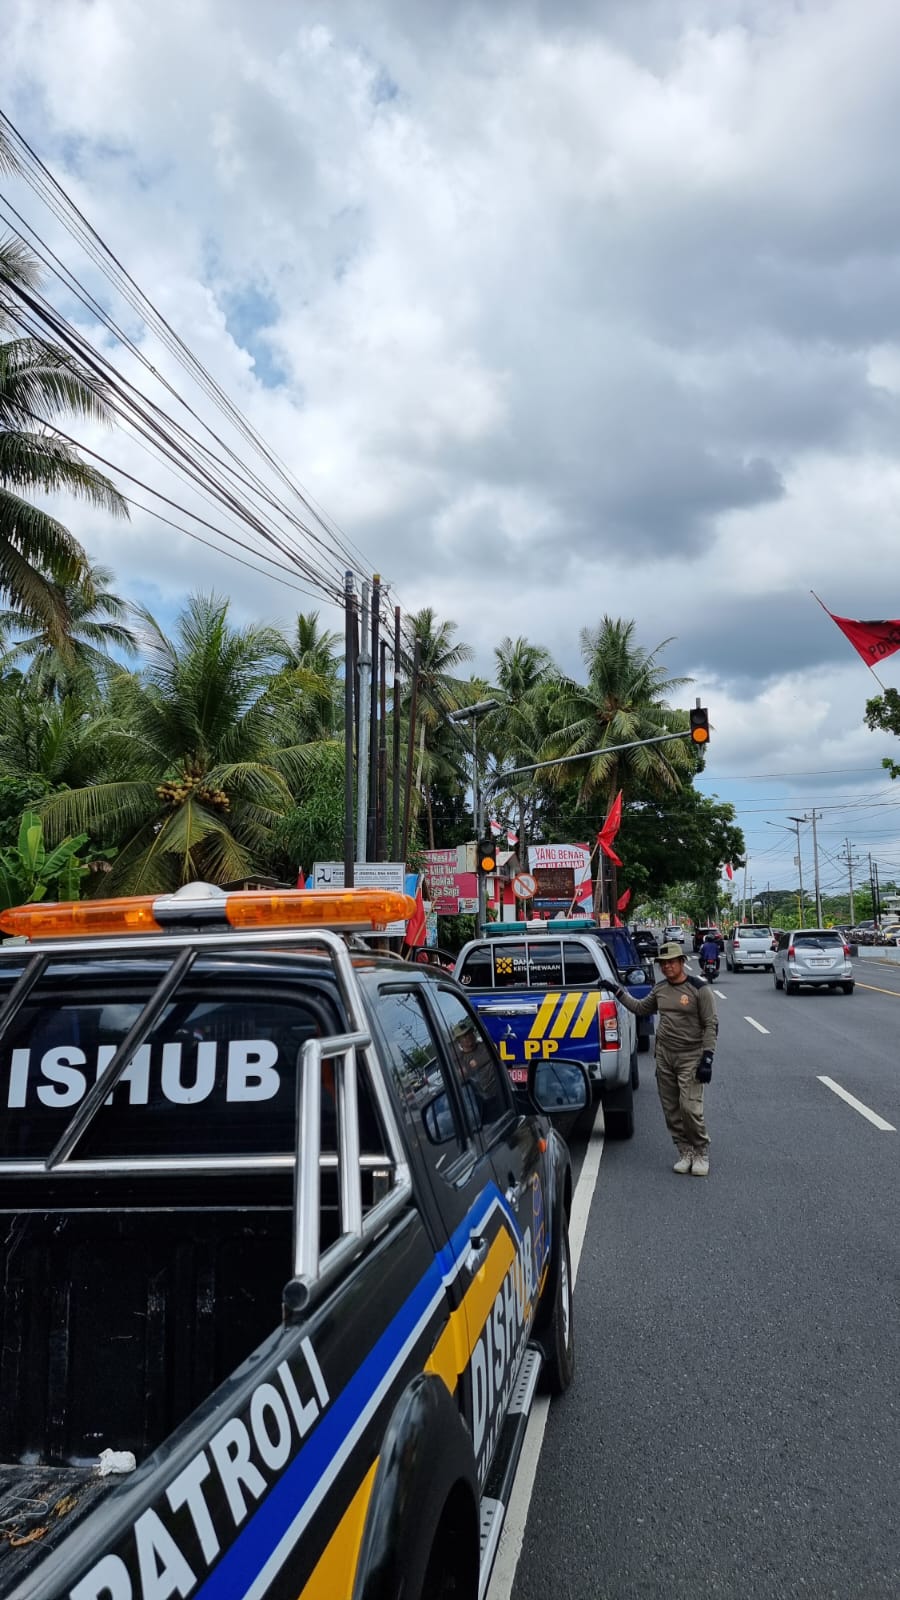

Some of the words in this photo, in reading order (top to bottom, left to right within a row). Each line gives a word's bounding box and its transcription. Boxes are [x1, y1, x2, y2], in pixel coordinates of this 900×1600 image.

[535, 848, 556, 860] YANG
[495, 1041, 516, 1060] L
[524, 1040, 559, 1060] PP
[472, 1226, 533, 1460] DISHUB
